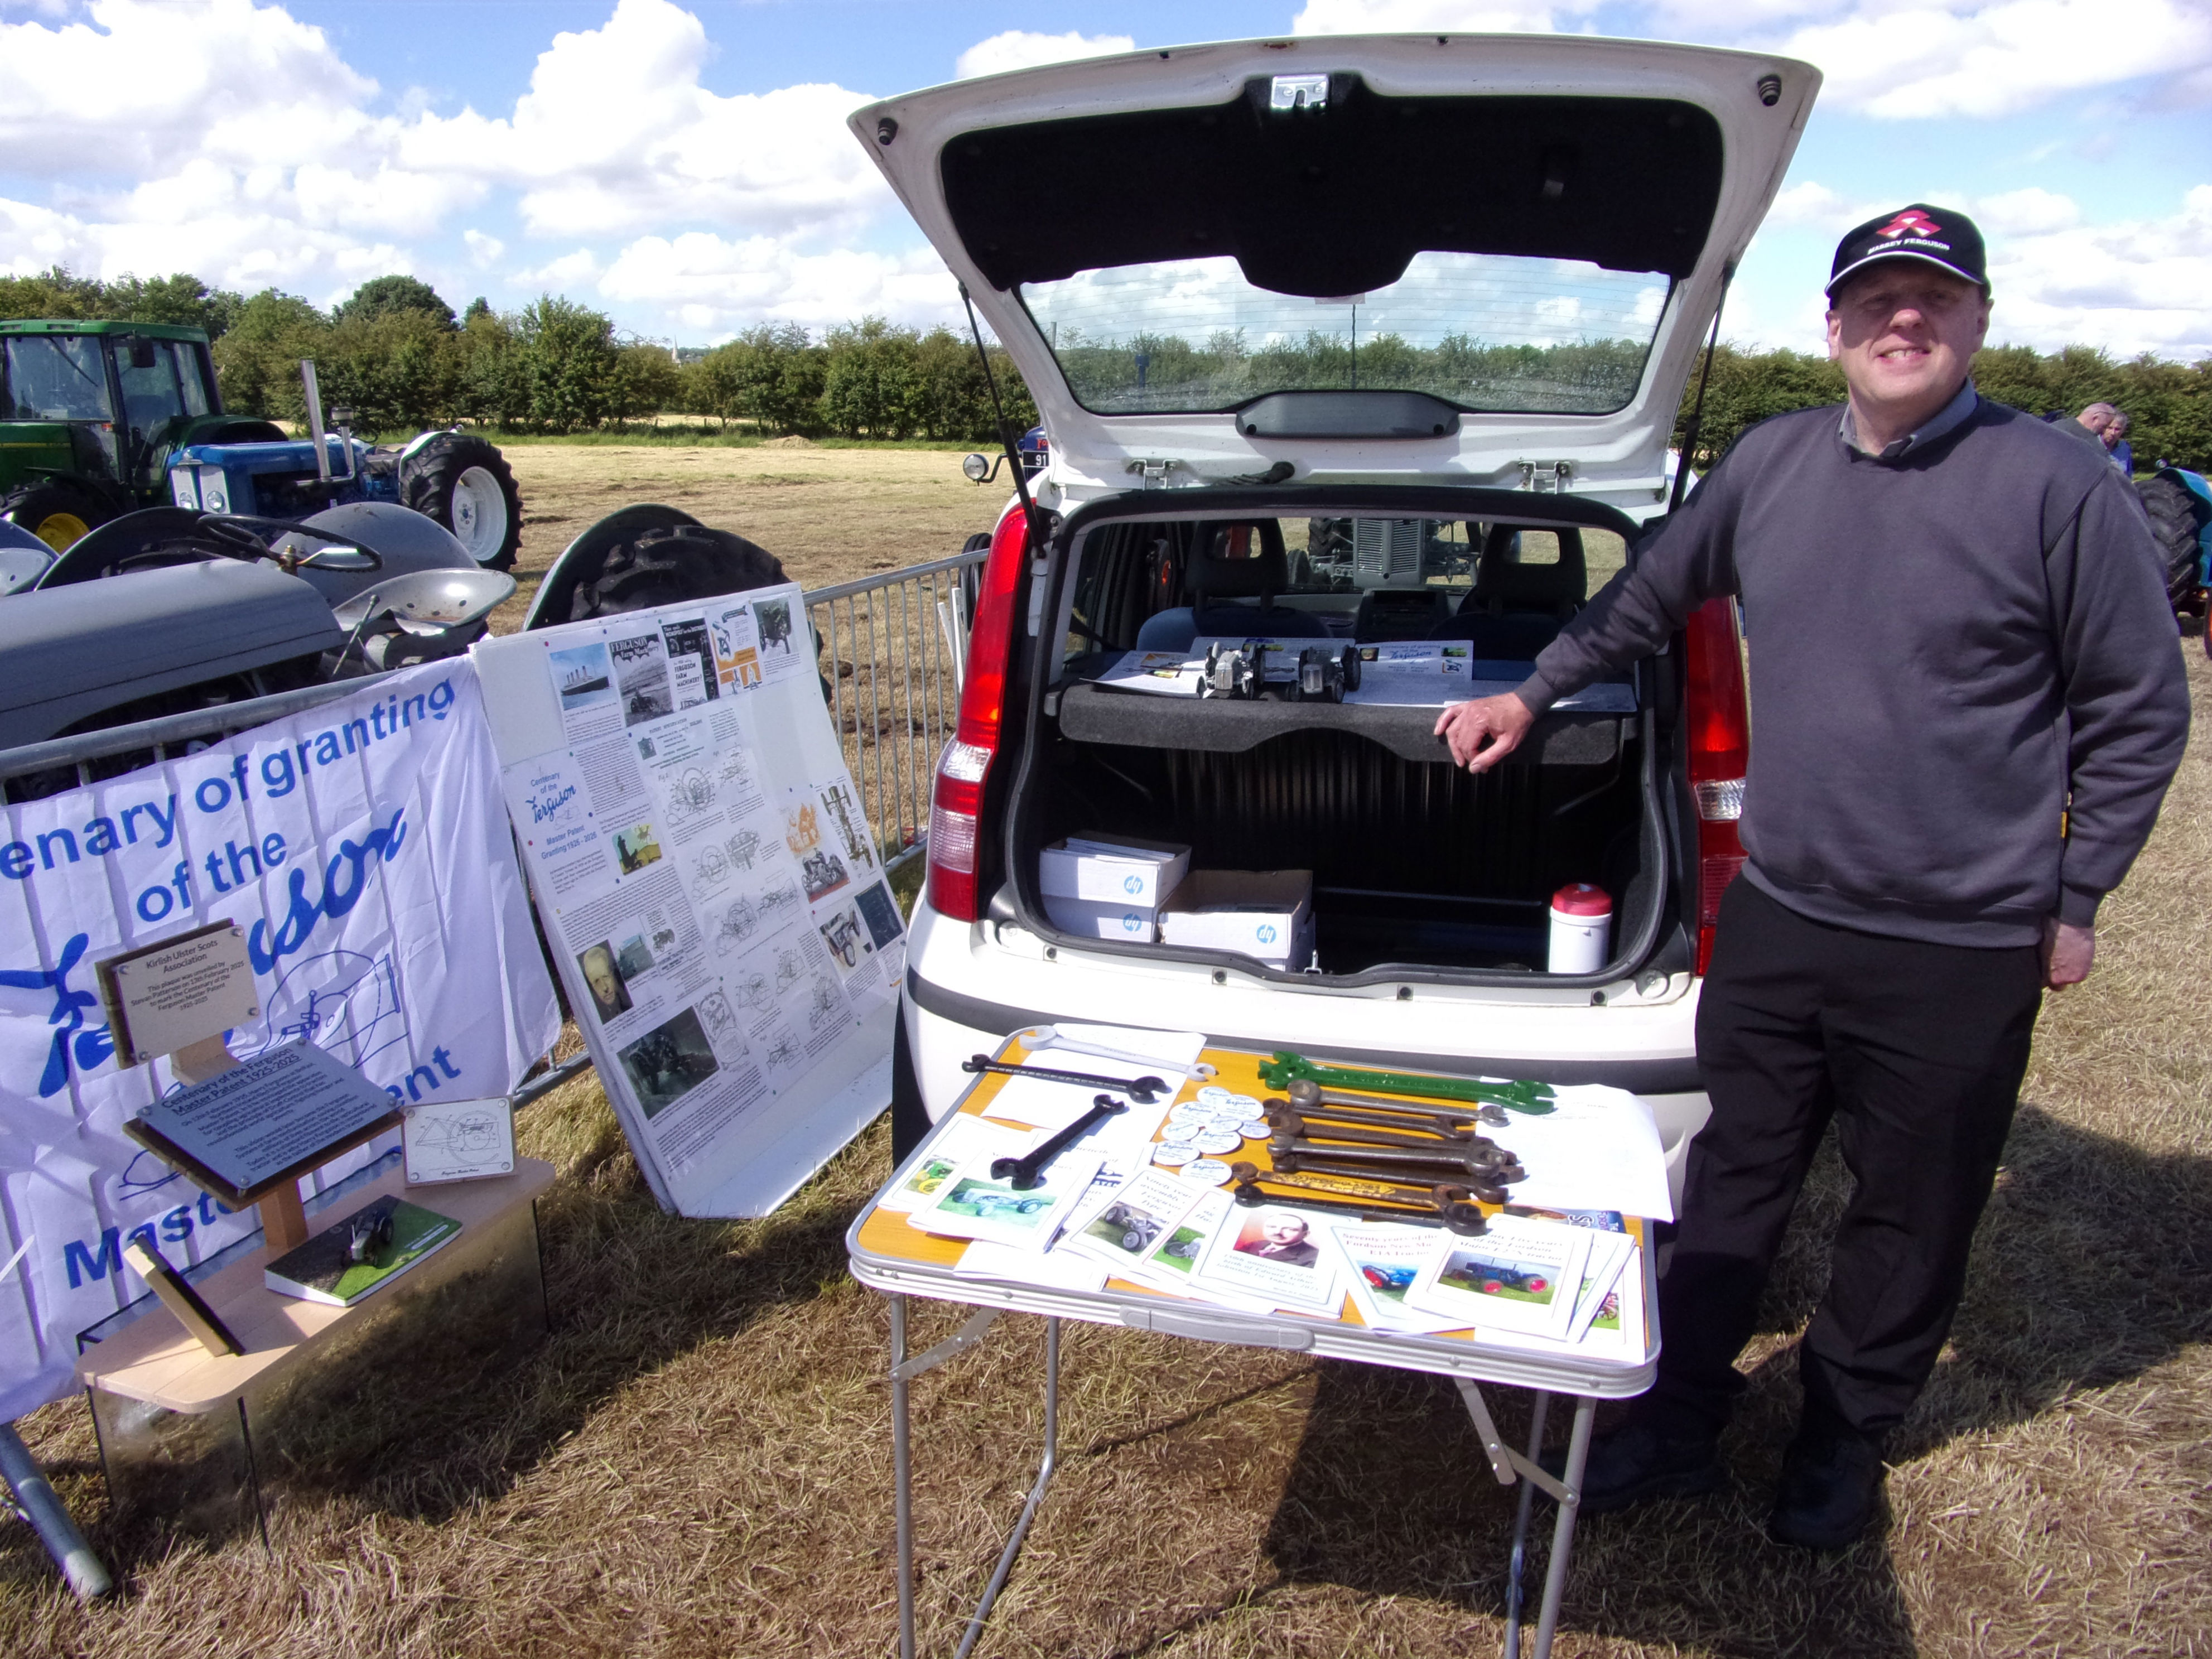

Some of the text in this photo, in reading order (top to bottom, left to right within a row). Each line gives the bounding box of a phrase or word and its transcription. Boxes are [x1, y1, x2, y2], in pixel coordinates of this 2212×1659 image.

[1867, 238, 1950, 255] MASSEY FERGUSON
[1035, 454, 1047, 466] 91
[610, 636, 648, 653] FERGUSON
[674, 662, 697, 673] FERGUSON
[194, 752, 250, 813] of
[261, 677, 456, 798] granting
[530, 771, 561, 787] Centenary
[548, 783, 558, 792] the
[525, 785, 577, 824] Ferguson
[546, 824, 585, 846] Master Patent
[541, 843, 567, 860] Granting
[136, 831, 289, 923] of the
[173, 946, 196, 960] Ulster
[198, 939, 218, 952] Scots
[163, 953, 207, 973] Association
[148, 983, 160, 992] This
[161, 977, 180, 987] plaque
[153, 983, 181, 999] Patterson
[205, 967, 229, 980] February
[158, 995, 172, 1004] mark
[184, 980, 213, 994] Centenary
[158, 983, 225, 1011] Ferguson Master Patent
[160, 1047, 295, 1110] Centenary of the Ferguson
[171, 1054, 300, 1115] Master Patent 1925-2025
